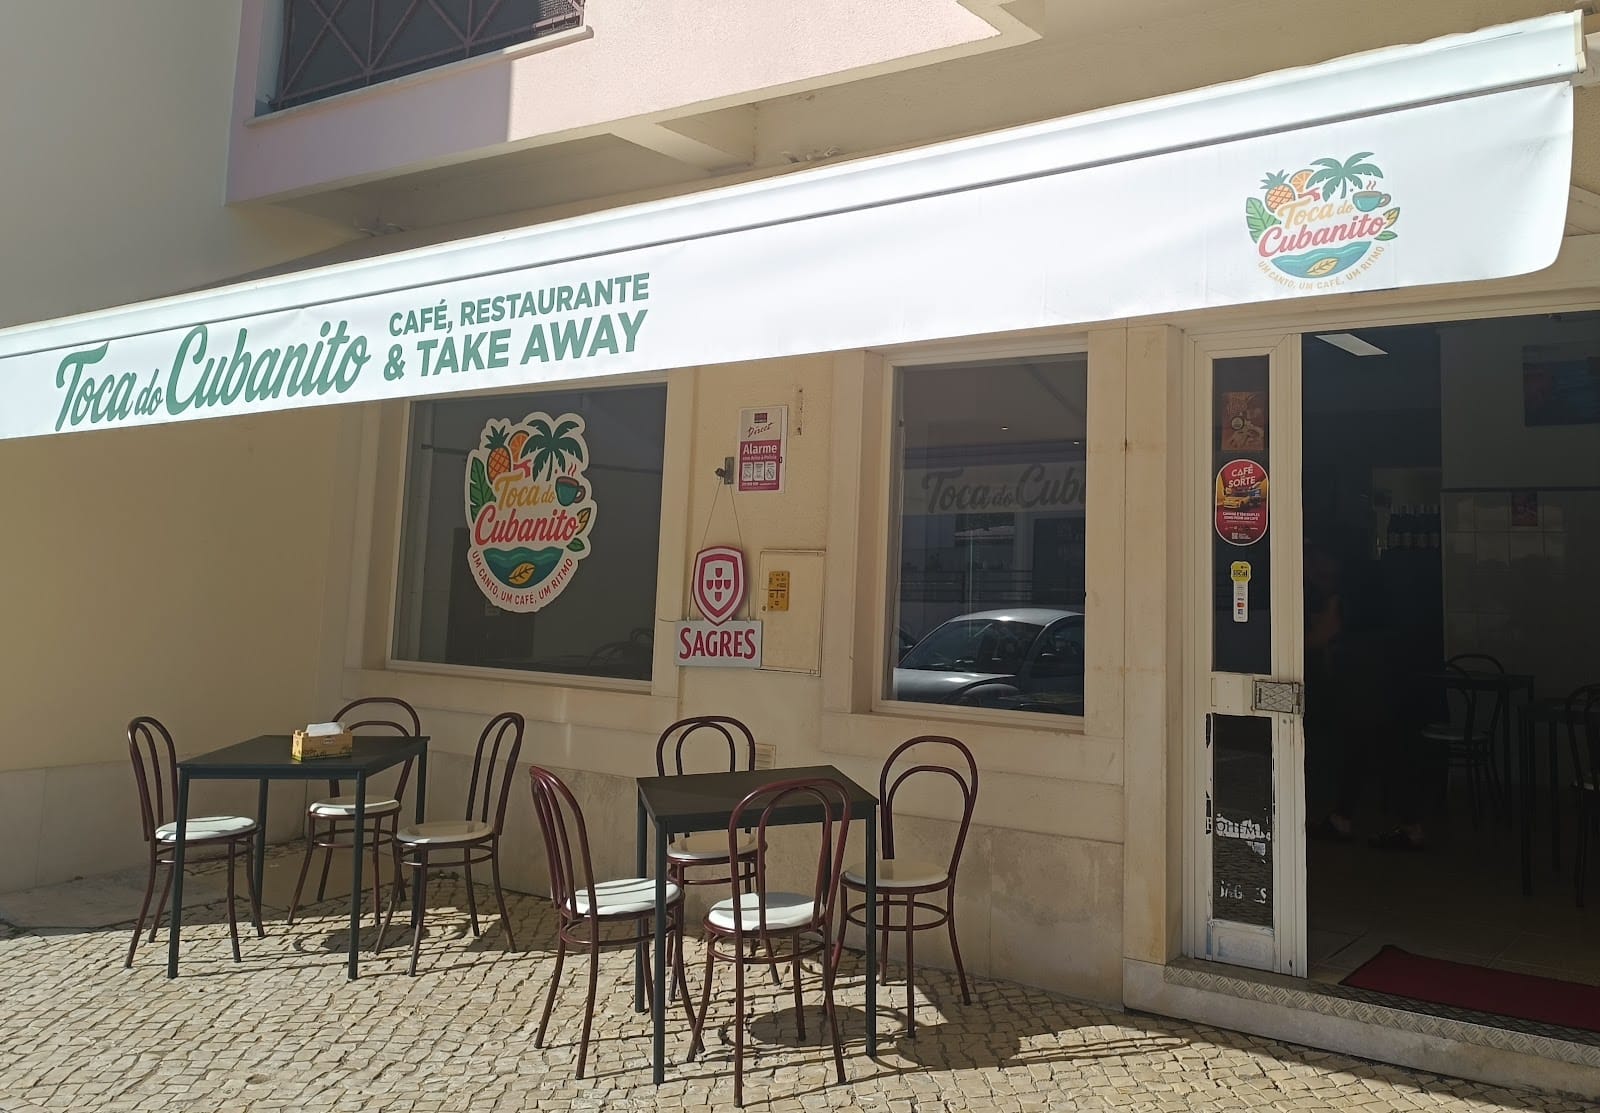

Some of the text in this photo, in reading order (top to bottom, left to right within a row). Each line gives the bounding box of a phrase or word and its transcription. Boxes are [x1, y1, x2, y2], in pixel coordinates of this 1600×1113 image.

[1277, 198, 1354, 230] Toca do
[1259, 214, 1386, 258] Cubanito
[1258, 261, 1270, 273] UM
[1268, 271, 1296, 289] CANTO,
[1317, 276, 1344, 289] CAFÉ,
[1346, 268, 1361, 281] UM
[1361, 246, 1385, 271] RITMO
[389, 272, 650, 333] CAFÉ, RESTAURANTE
[383, 309, 649, 381] & TAKE AWAY
[55, 320, 371, 431] Toca do Cubanito
[743, 443, 778, 455] Alarme
[748, 422, 774, 438] Direct
[922, 467, 991, 514] Toca
[991, 485, 1013, 508] do
[1228, 476, 1256, 488] SORTE
[1231, 463, 1254, 477] CAFÉ
[494, 471, 555, 511] Toca do
[475, 505, 579, 546] Cubanito
[472, 550, 573, 605] UM CANTO, UM CAFÉ, UM RITMO
[679, 627, 756, 660] SAGRES
